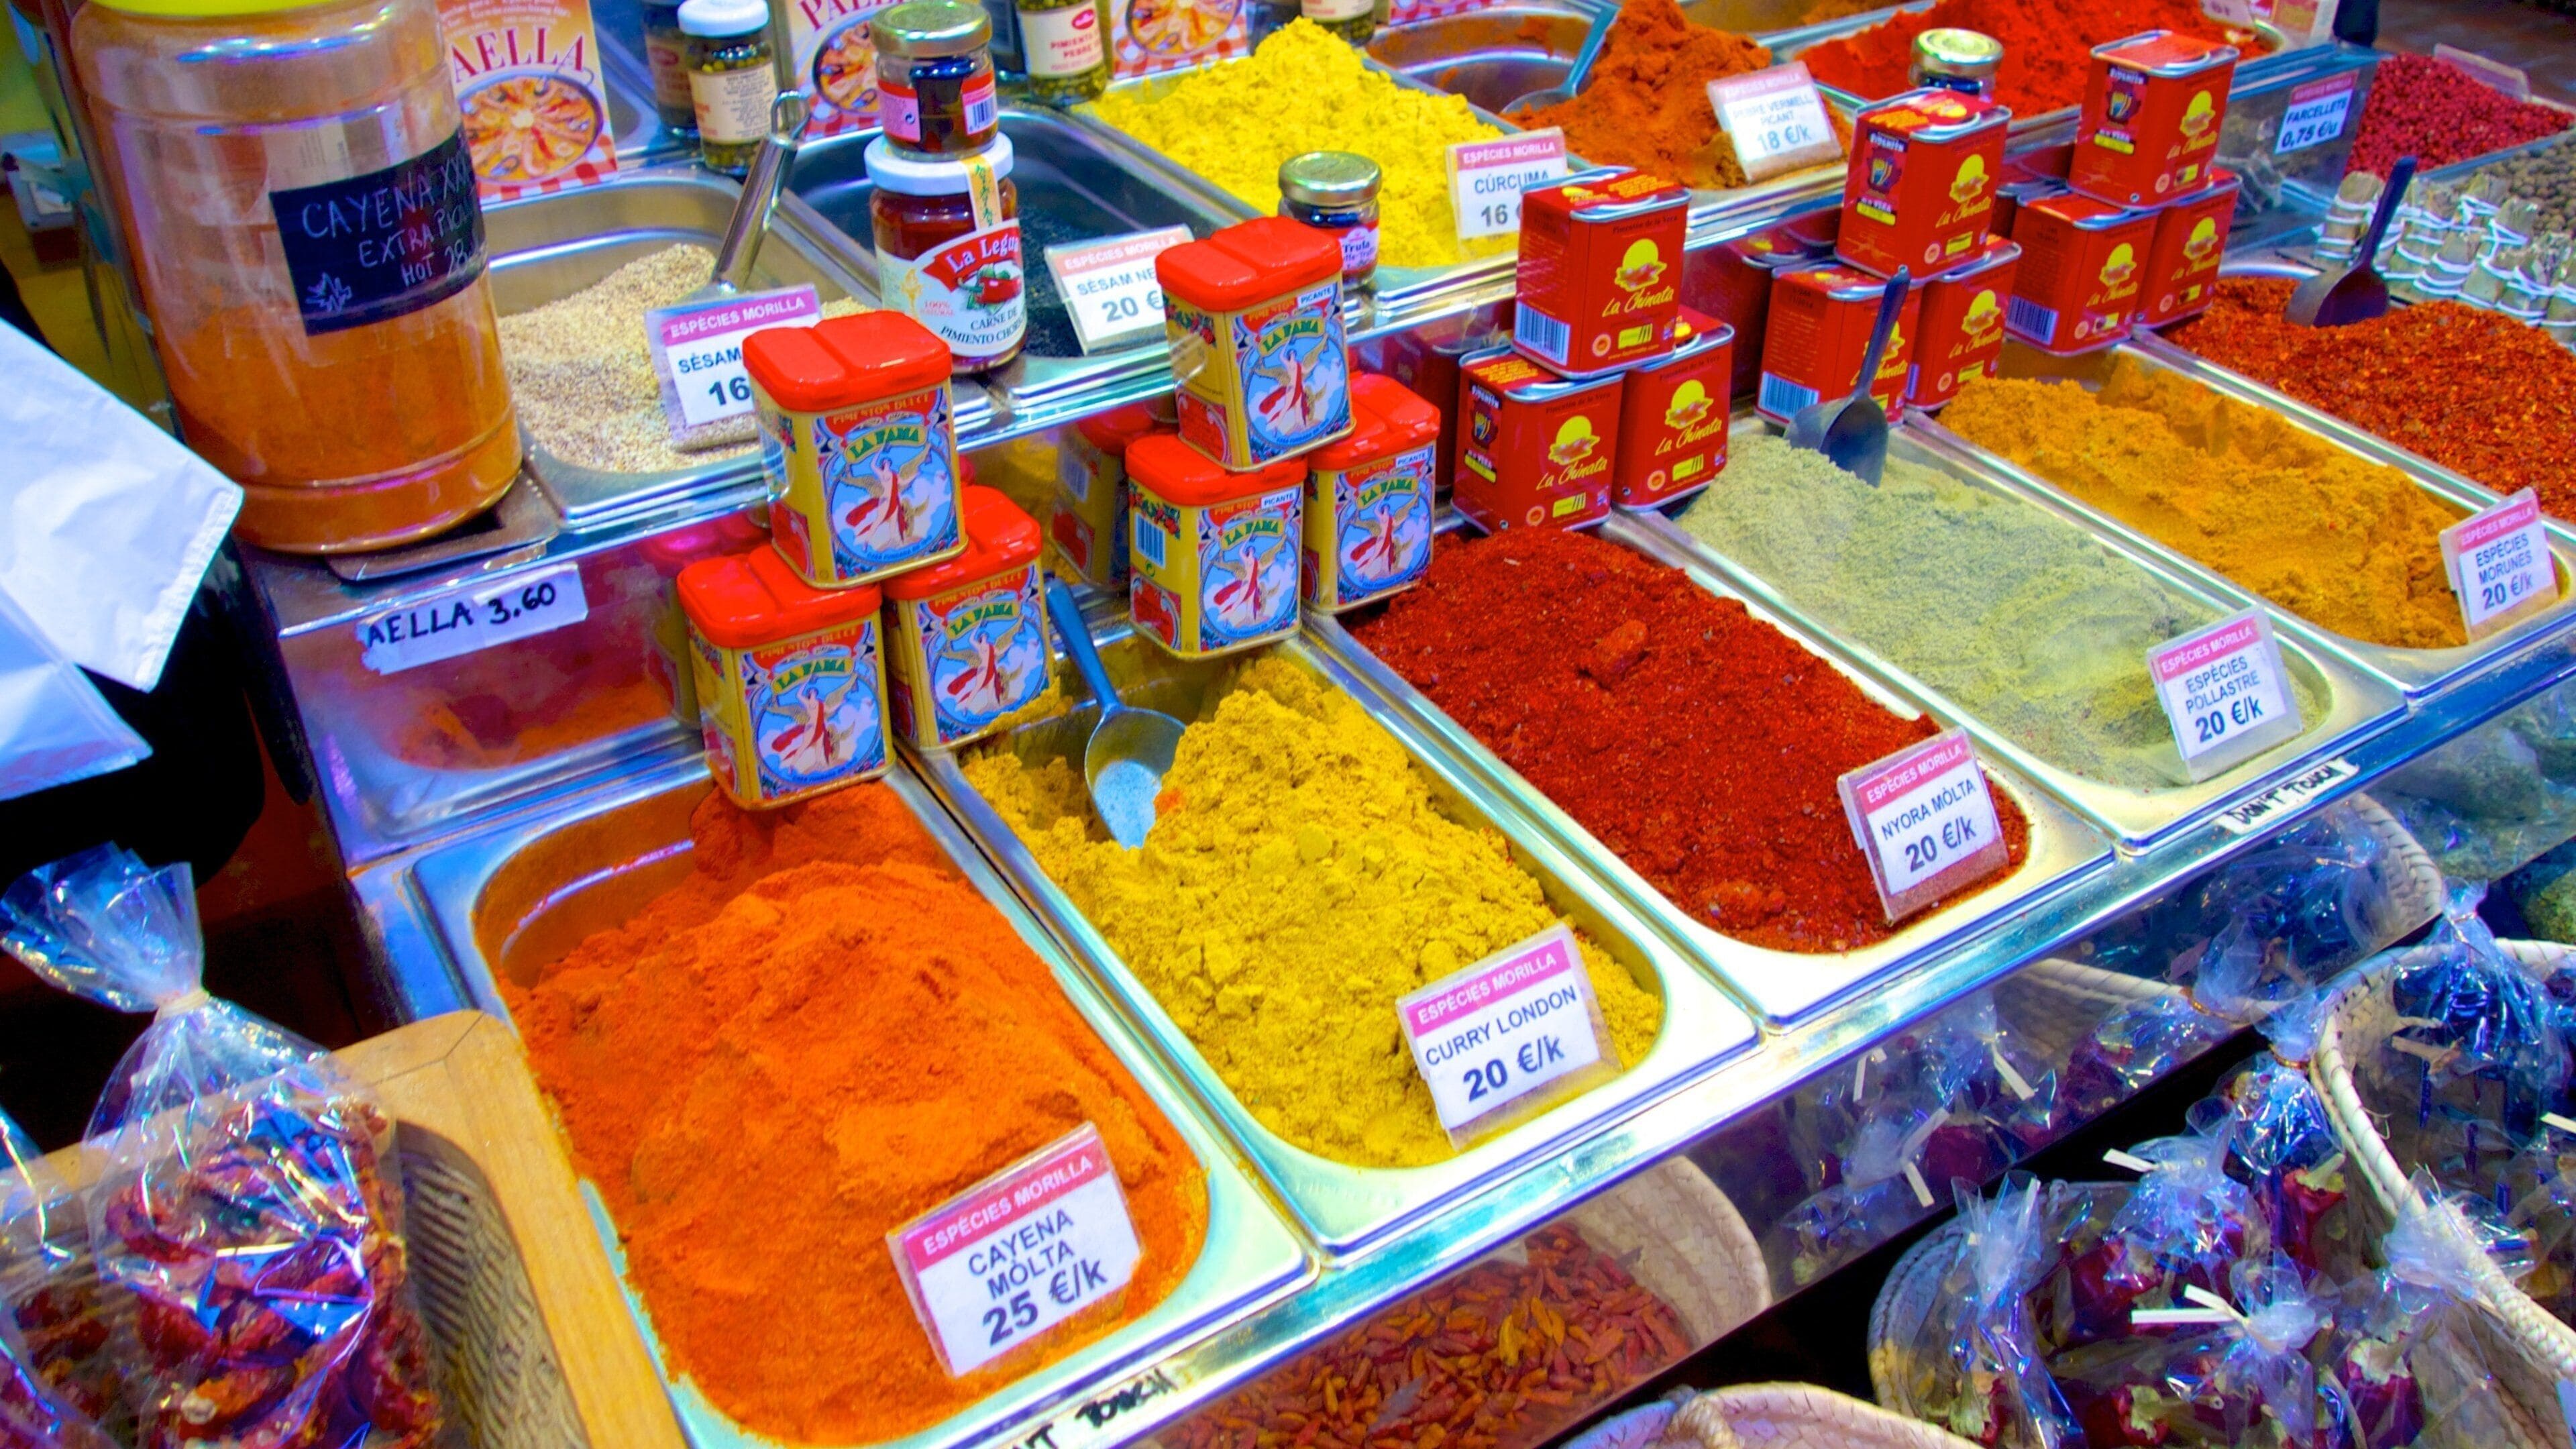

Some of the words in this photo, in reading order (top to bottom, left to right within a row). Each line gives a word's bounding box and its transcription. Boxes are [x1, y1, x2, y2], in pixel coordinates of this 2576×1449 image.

[452, 27, 584, 83] AELLA
[1758, 130, 1781, 151] 18
[2281, 123, 2316, 148] 0,75
[302, 170, 435, 237] CAYENA
[1481, 204, 1509, 228] 16
[358, 223, 434, 268] EXTRA
[945, 250, 975, 272] La
[400, 251, 435, 286] HOT
[743, 297, 806, 321] MORILLA
[1102, 297, 1140, 323] 20
[1602, 298, 1621, 318] La
[1624, 286, 1675, 313] Chinata
[941, 325, 995, 345] PIMIENTO
[970, 313, 1007, 331] CARNE
[1263, 333, 1283, 353] LA
[708, 376, 751, 407] 16
[849, 438, 874, 460] LA
[1654, 437, 1672, 456] La
[1676, 417, 1723, 449] Chinata
[1536, 472, 1555, 491] La
[1558, 455, 1608, 485] Chinata
[2478, 549, 2534, 586] MORUNES
[2482, 582, 2507, 610] 20
[2510, 572, 2534, 596] €/k
[367, 600, 474, 648] AELLA
[487, 581, 557, 625] 3.60
[950, 616, 974, 637] LA
[2209, 625, 2254, 653] MORILLA
[775, 670, 800, 690] LA
[2185, 669, 2261, 715] POLLASTRE
[2195, 710, 2226, 744] 20
[2231, 695, 2265, 726] €/k
[1917, 743, 1964, 777] MORILLA
[1880, 802, 1931, 841] NYORA
[1904, 834, 1938, 873] 20
[1942, 814, 1978, 850] €/k
[1491, 952, 1558, 993] MORILLA
[1425, 1022, 1493, 1067] CURRY
[1495, 984, 1578, 1036] LONDON
[1462, 1058, 1509, 1103] 20
[1516, 1034, 1566, 1075] €/k
[1012, 1155, 1095, 1209] MORILLA
[967, 1207, 1075, 1277] CAYENA
[981, 1289, 1039, 1348] 25
[1048, 1258, 1110, 1306] €/k
